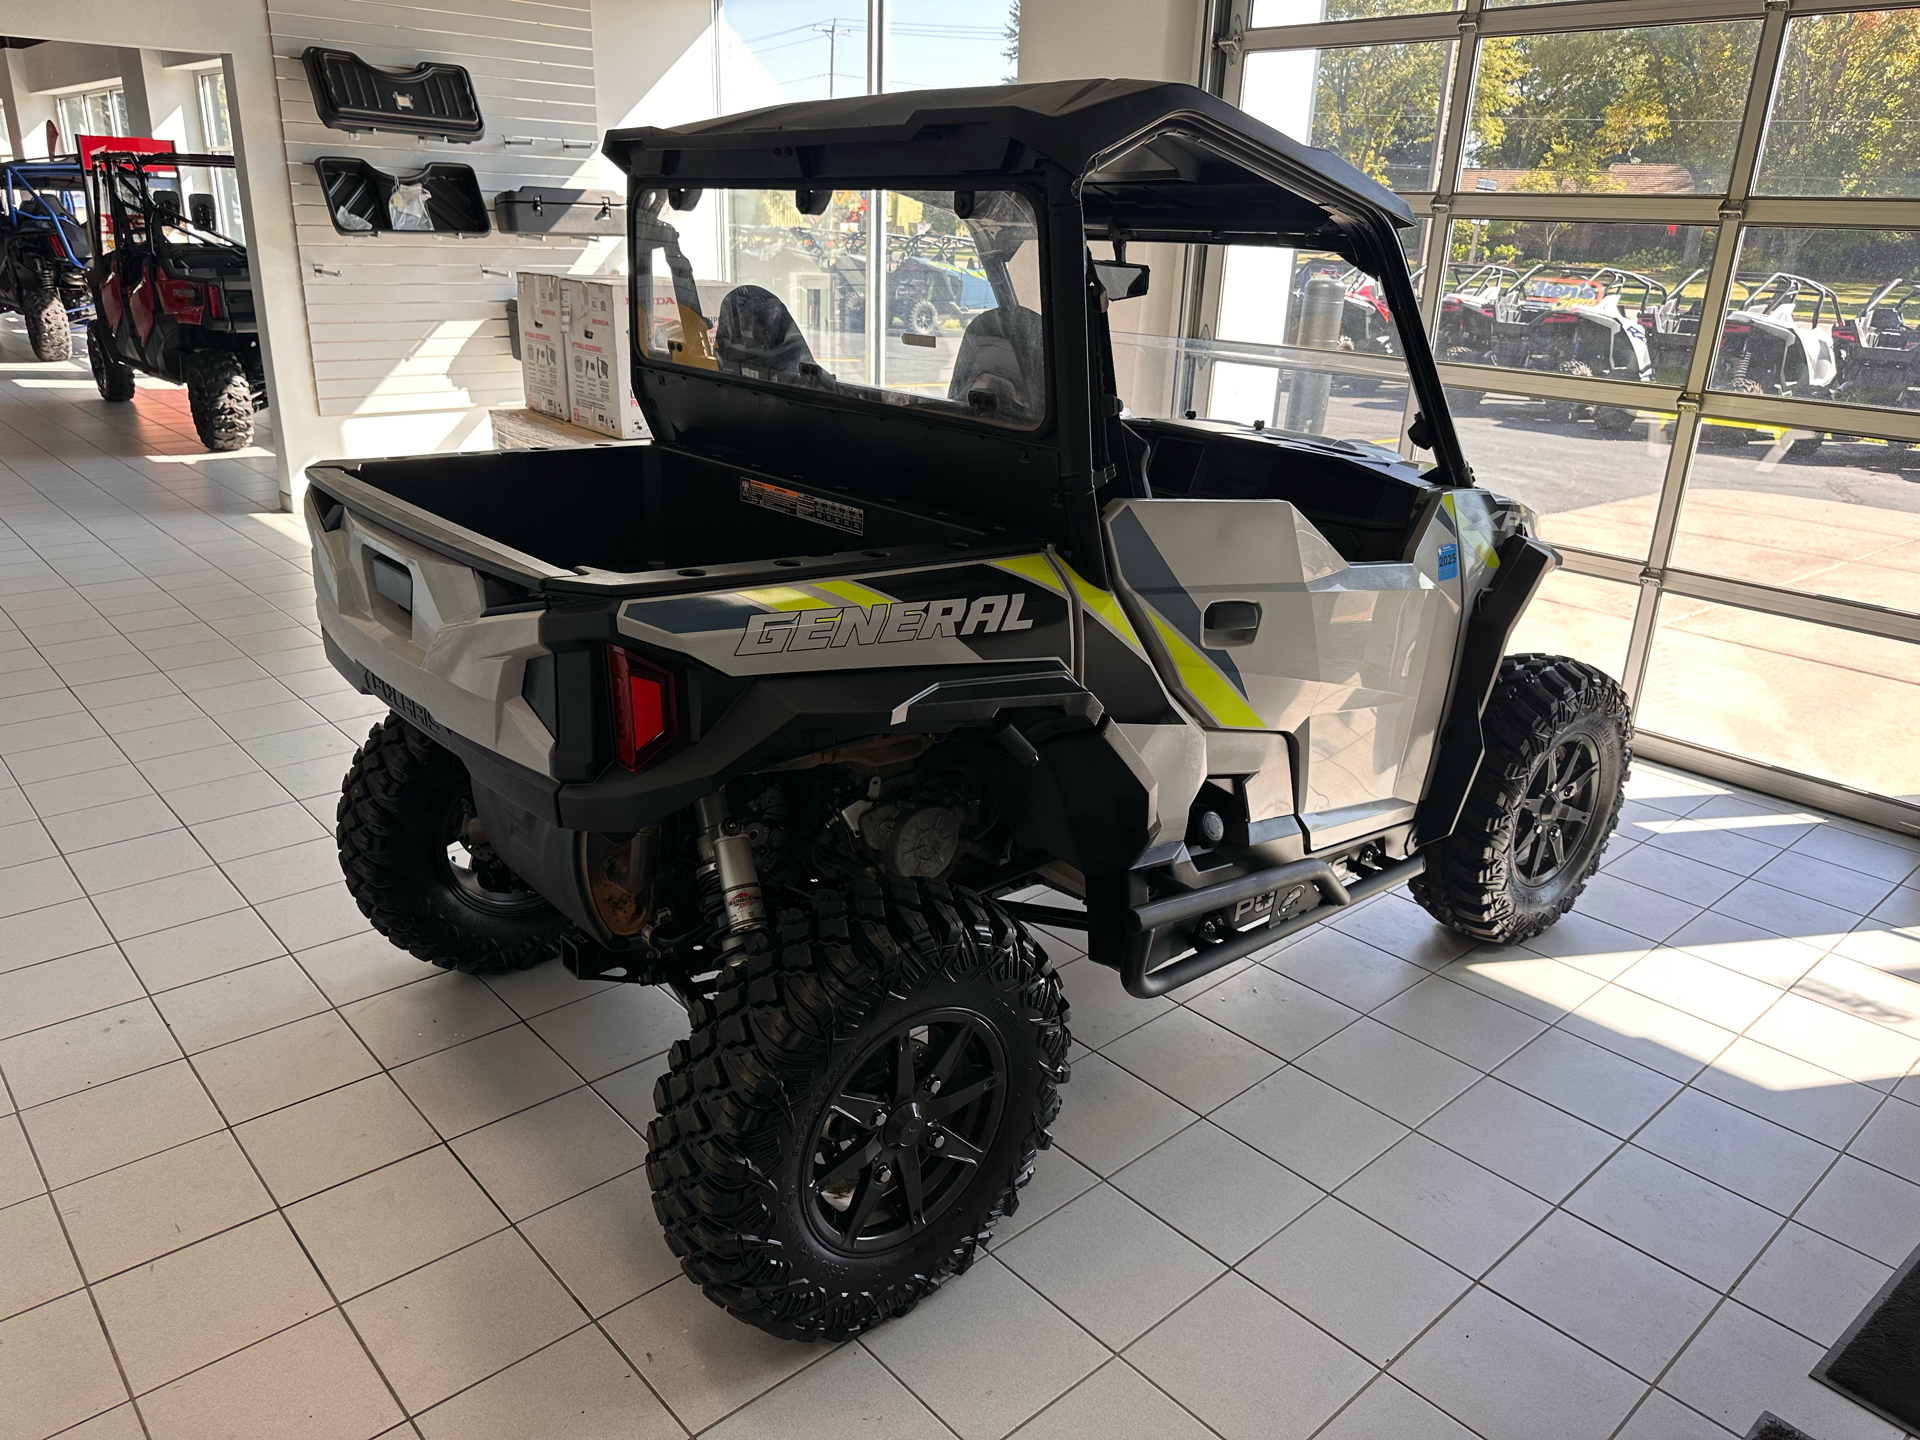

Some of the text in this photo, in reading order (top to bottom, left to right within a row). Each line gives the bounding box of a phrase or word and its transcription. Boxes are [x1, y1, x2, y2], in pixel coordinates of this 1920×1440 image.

[1552, 295, 1597, 310] Sports
[1440, 552, 1457, 567] 2025
[734, 593, 1034, 656] GENERAL
[371, 672, 441, 736] POLARIS
[728, 896, 747, 907] Walker
